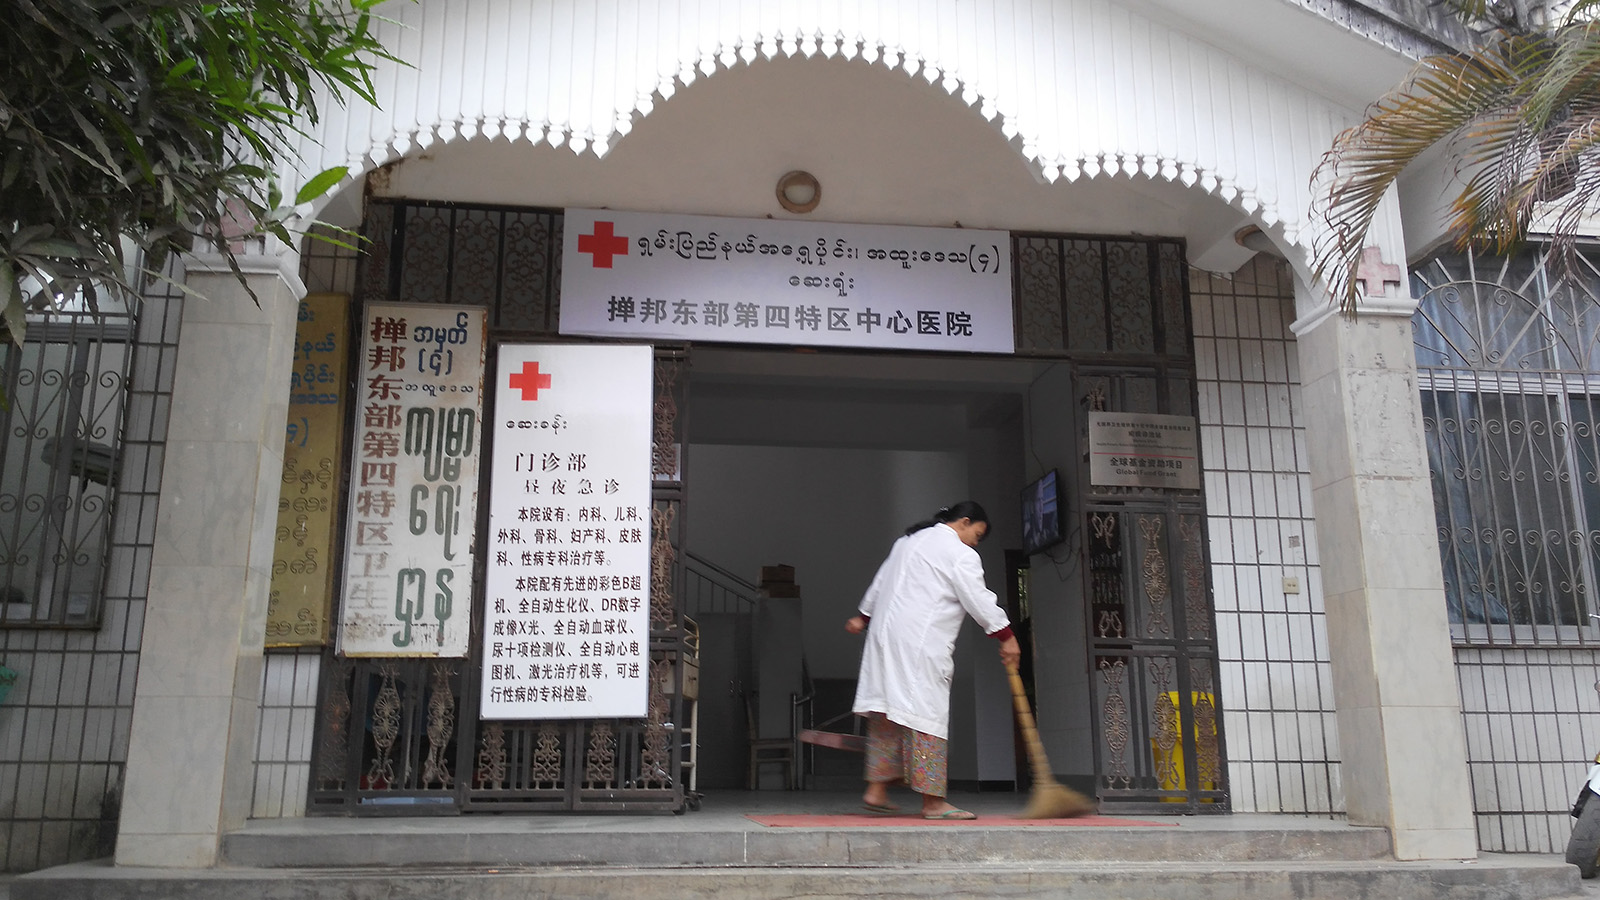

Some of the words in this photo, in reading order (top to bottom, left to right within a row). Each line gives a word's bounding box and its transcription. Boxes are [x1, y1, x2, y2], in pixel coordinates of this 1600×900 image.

[607, 296, 974, 337] 掸邦东部第四特区中心医院
[515, 452, 587, 472] 门诊部
[523, 478, 620, 495] 昼夜急诊
[515, 575, 642, 592] 本院配有先进的彩色B超
